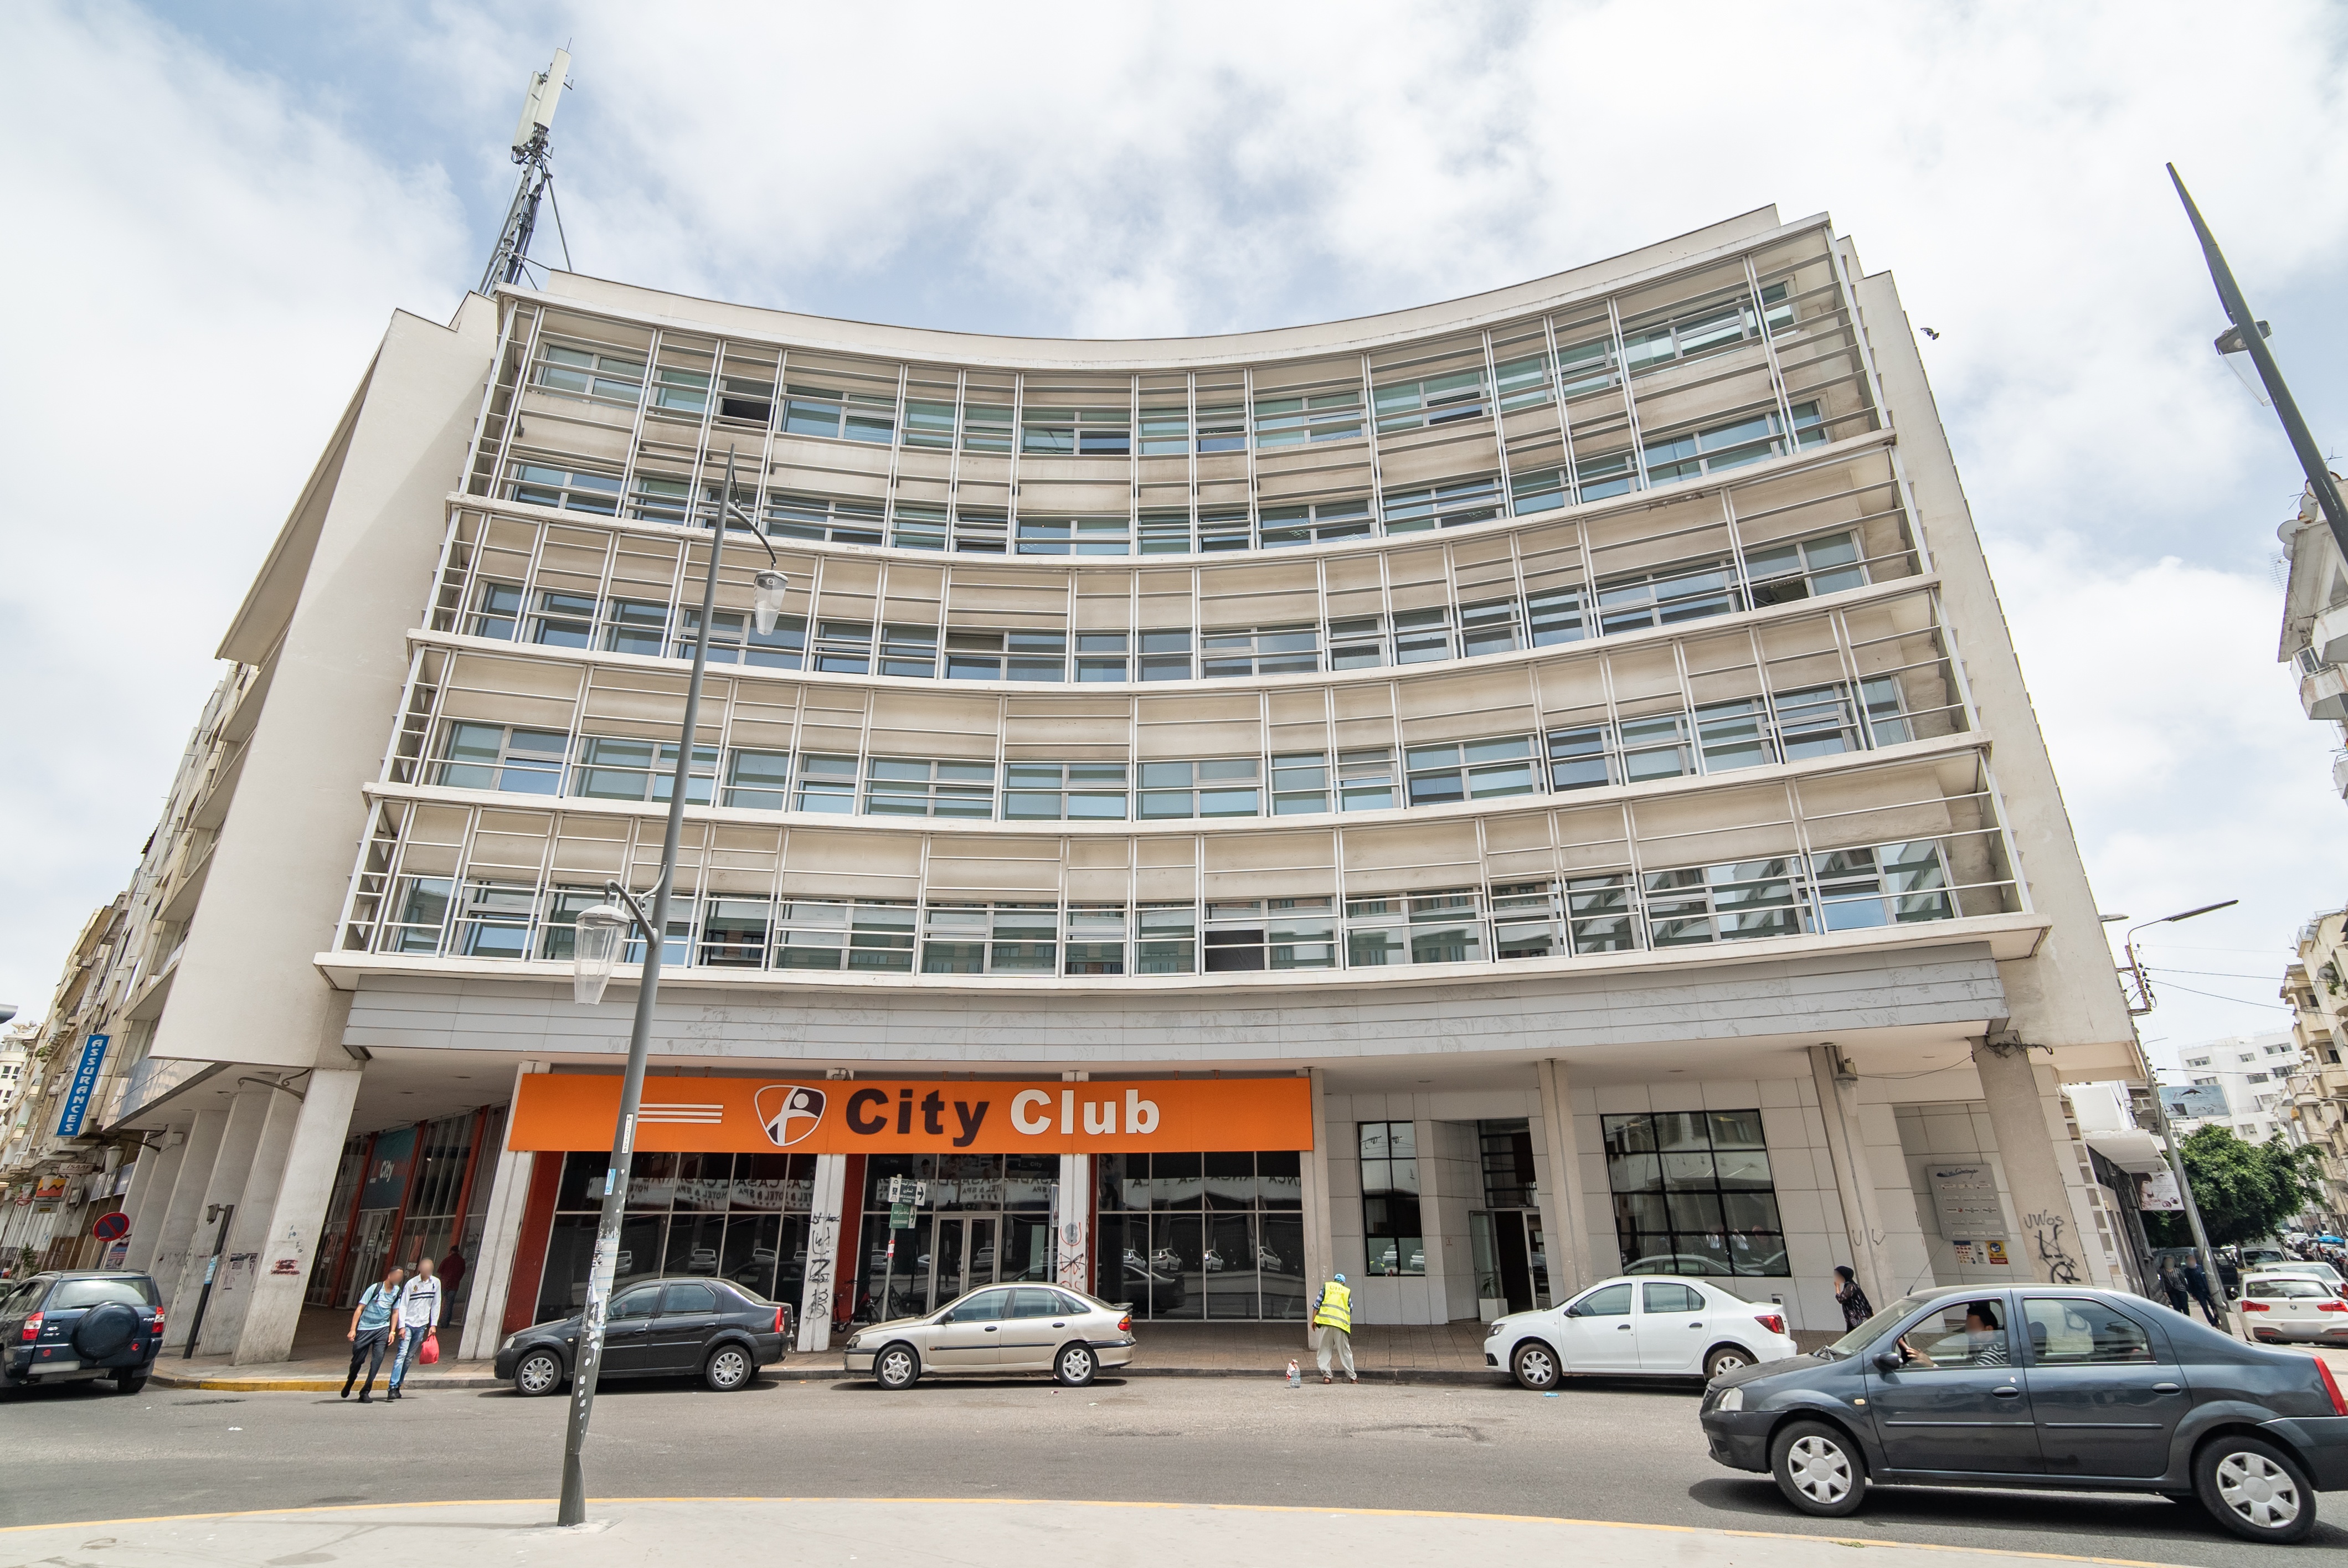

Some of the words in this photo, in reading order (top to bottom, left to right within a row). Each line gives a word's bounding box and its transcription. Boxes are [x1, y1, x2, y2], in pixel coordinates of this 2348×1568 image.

[64, 1039, 104, 1132] ASSURANCES
[846, 1088, 990, 1147] City
[1011, 1089, 1160, 1135] Club
[379, 1160, 395, 1183] City
